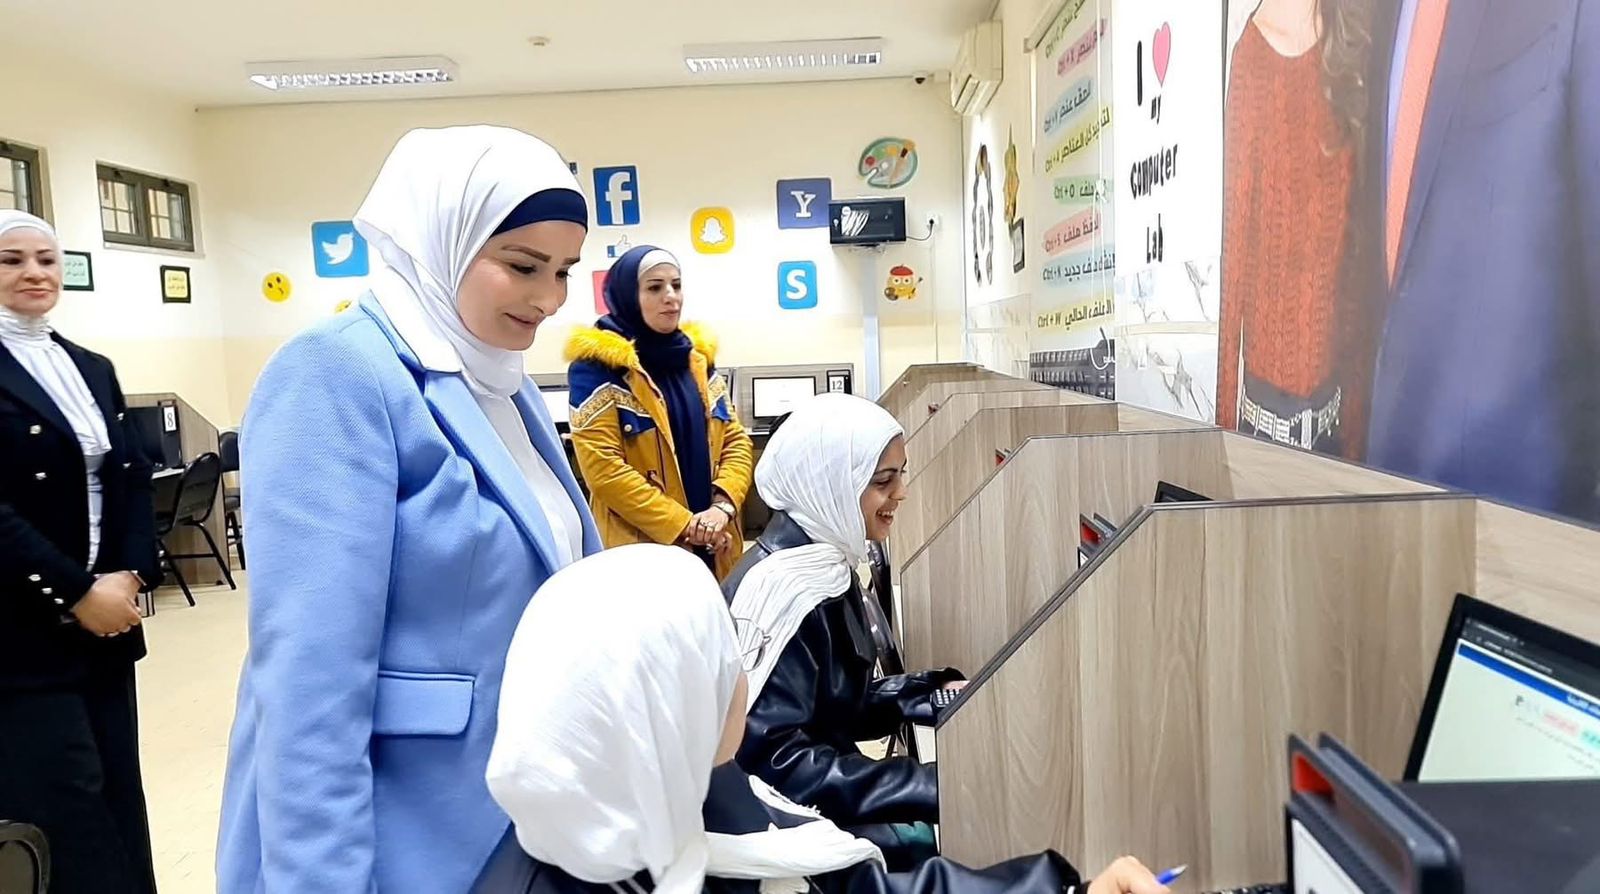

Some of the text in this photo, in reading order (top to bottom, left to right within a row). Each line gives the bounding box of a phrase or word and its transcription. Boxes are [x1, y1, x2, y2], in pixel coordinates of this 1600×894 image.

[1137, 40, 1143, 107] I
[1151, 94, 1161, 125] my
[605, 171, 632, 225] f
[790, 190, 817, 218] Y
[1146, 212, 1164, 264] Lab
[785, 268, 808, 300] S
[1064, 263, 1081, 283] جديد
[1038, 314, 1049, 328] Ctrl
[1064, 305, 1088, 331] الحالي
[832, 380, 843, 390] 12
[167, 412, 174, 428] 8
